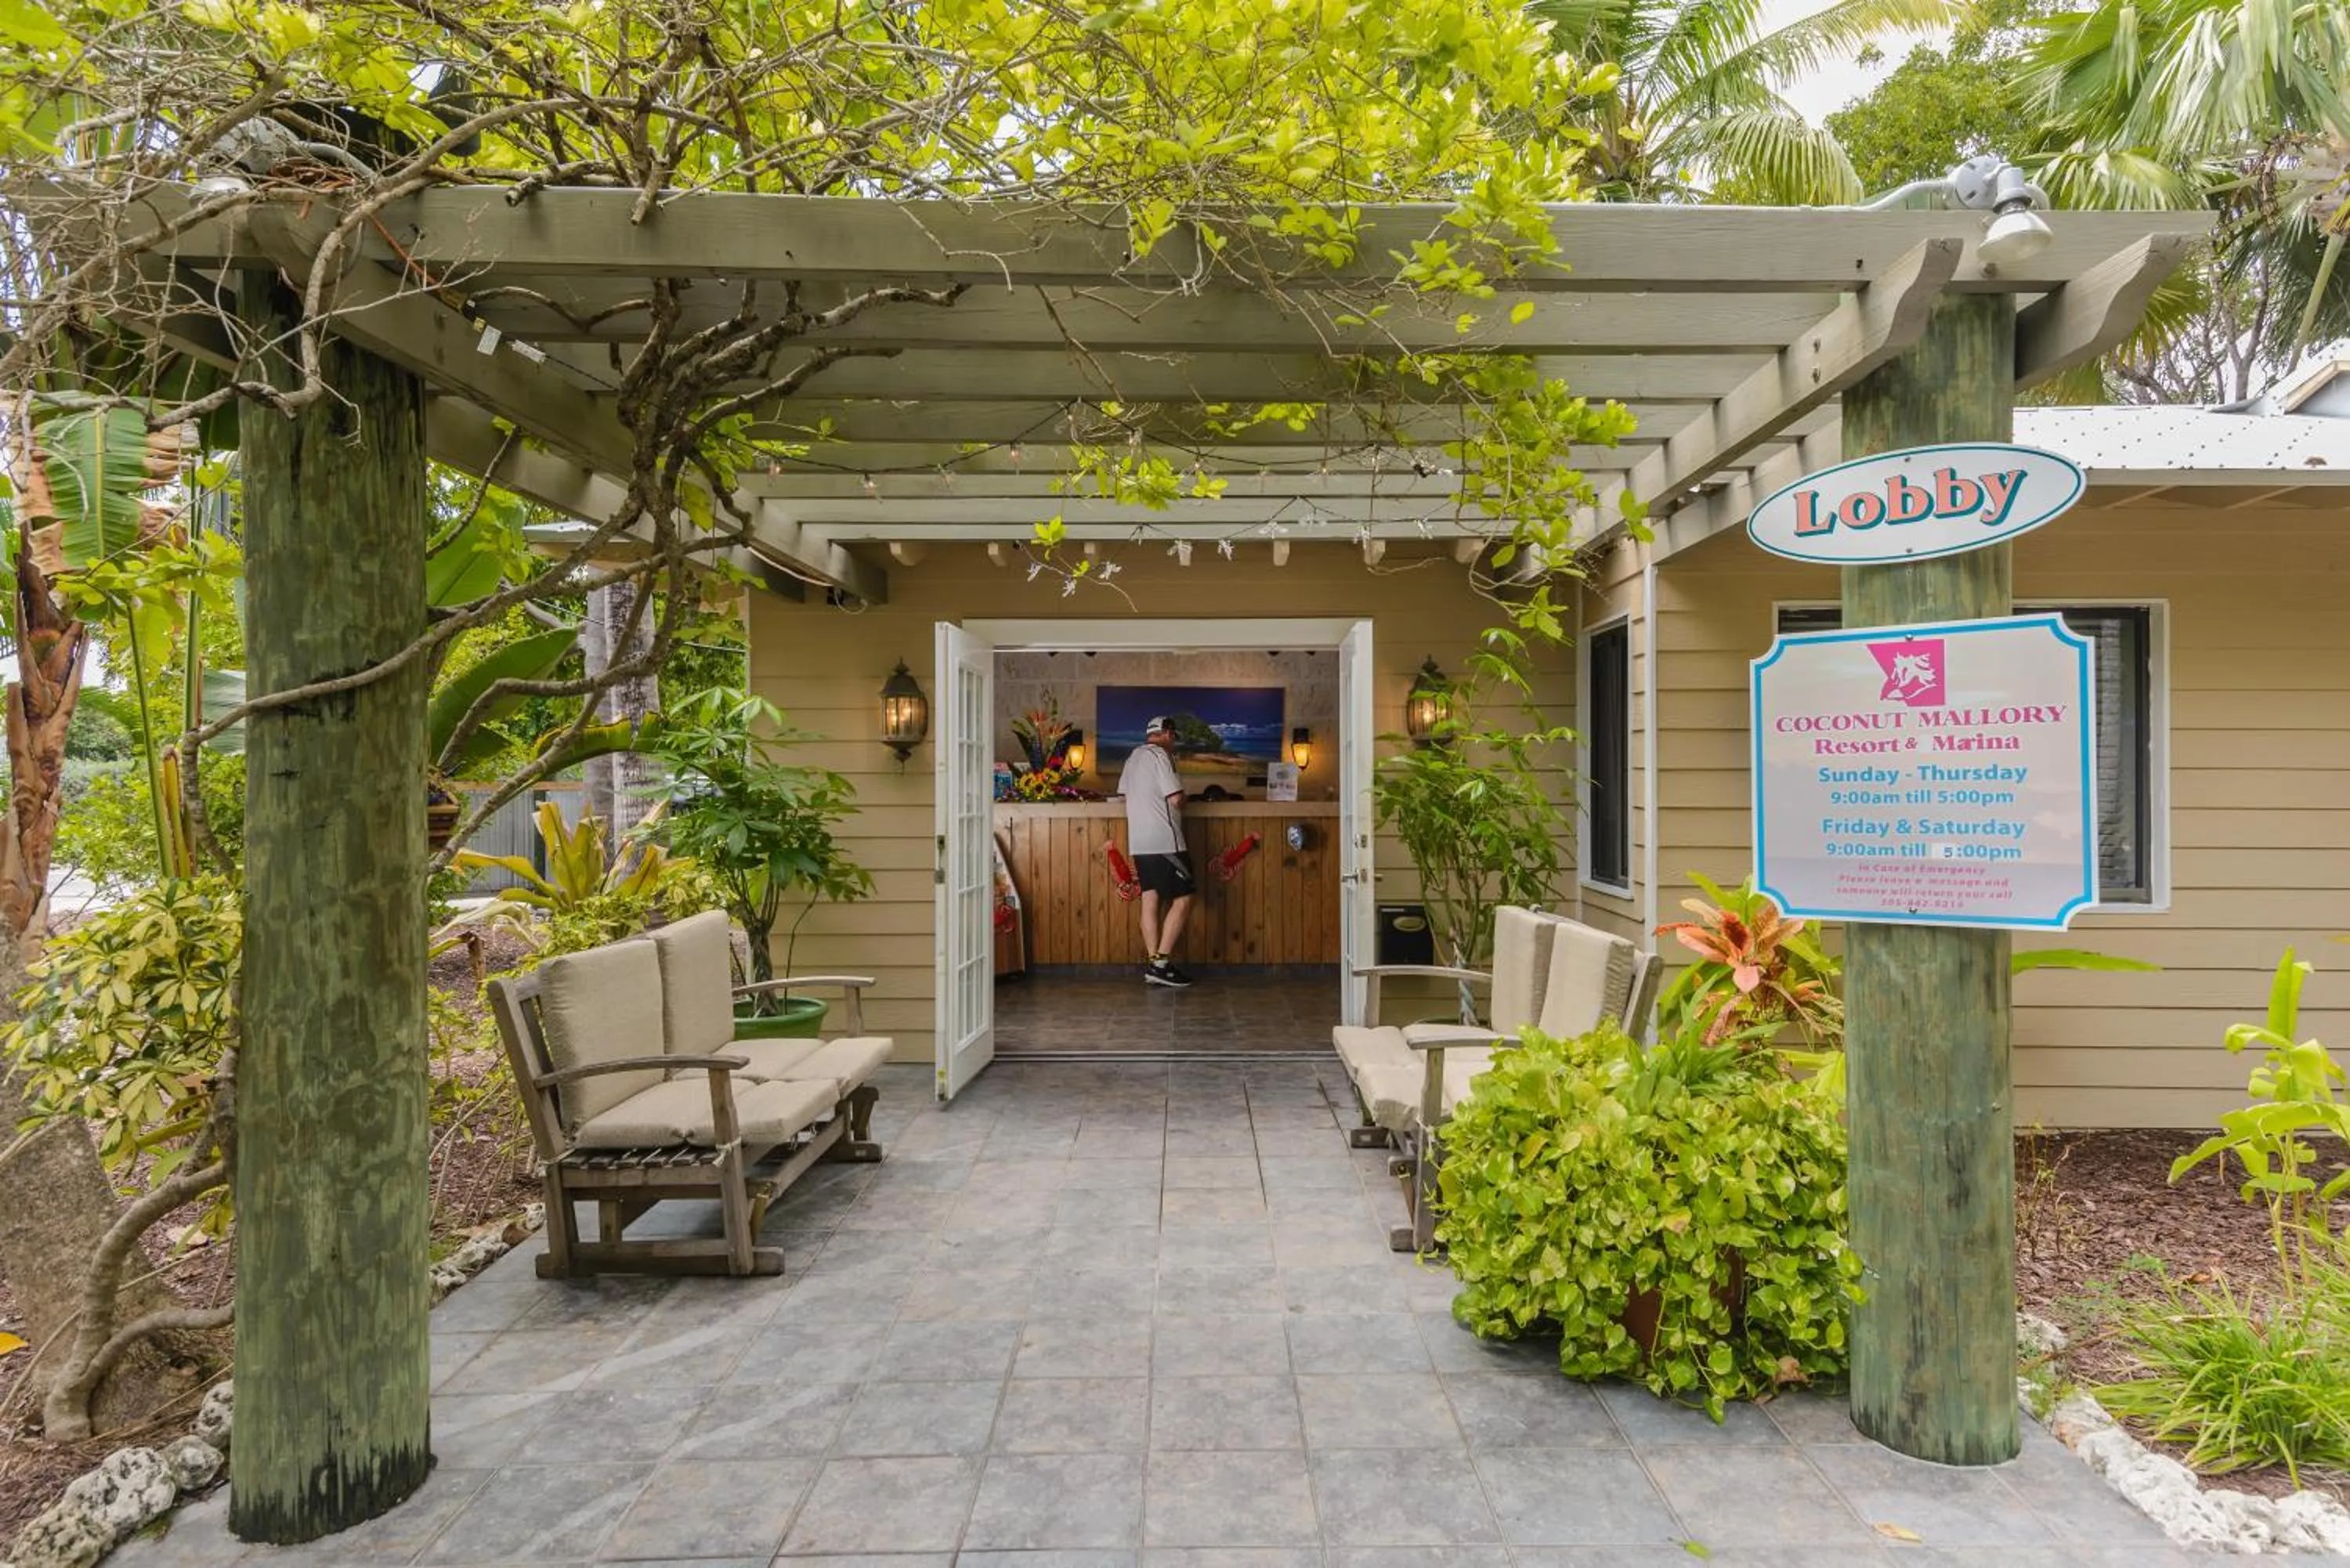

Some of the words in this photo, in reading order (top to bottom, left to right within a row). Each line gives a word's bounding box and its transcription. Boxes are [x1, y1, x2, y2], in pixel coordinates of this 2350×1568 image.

[1794, 467, 2028, 537] Lobby
[1776, 711, 1907, 732] COCONUT
[1918, 704, 2067, 727] MALLORY
[1814, 737, 1899, 754] Resort
[1905, 737, 1918, 750] &
[1932, 733, 2021, 751] Marina
[1818, 766, 1900, 785] Sunday
[1918, 764, 2028, 784] Thursday
[1831, 791, 1900, 804] 9:00am
[1906, 789, 1931, 804] till
[1937, 789, 2015, 807] 5:00pm
[1822, 818, 1889, 838] Friday
[1896, 819, 1911, 835] &
[1919, 819, 2026, 839] Saturday
[1826, 843, 1895, 856] 9:00am
[1900, 842, 1926, 857] till
[1919, 865, 1986, 875] Emergency
